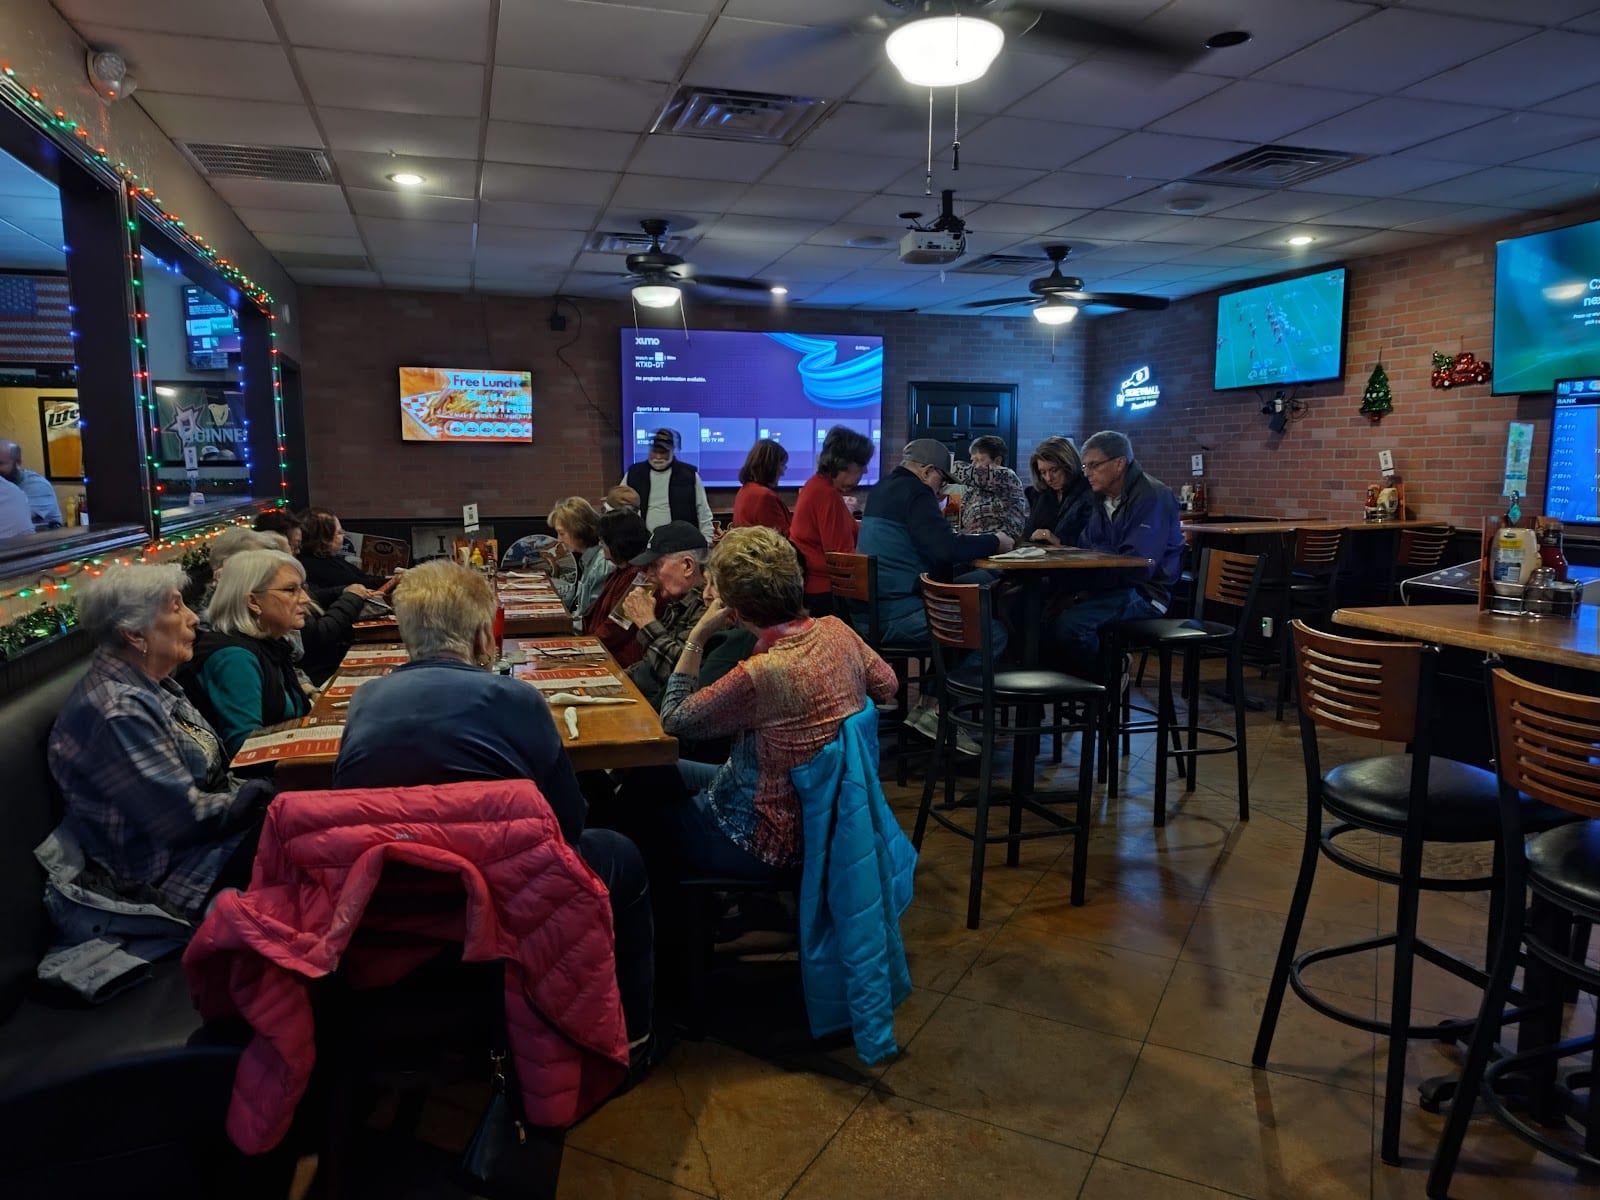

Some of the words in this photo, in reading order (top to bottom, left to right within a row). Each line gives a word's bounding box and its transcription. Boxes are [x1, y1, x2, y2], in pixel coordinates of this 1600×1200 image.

[635, 361, 665, 369] KTXD-DT
[453, 374, 480, 387] Free
[482, 376, 518, 388] Lunch
